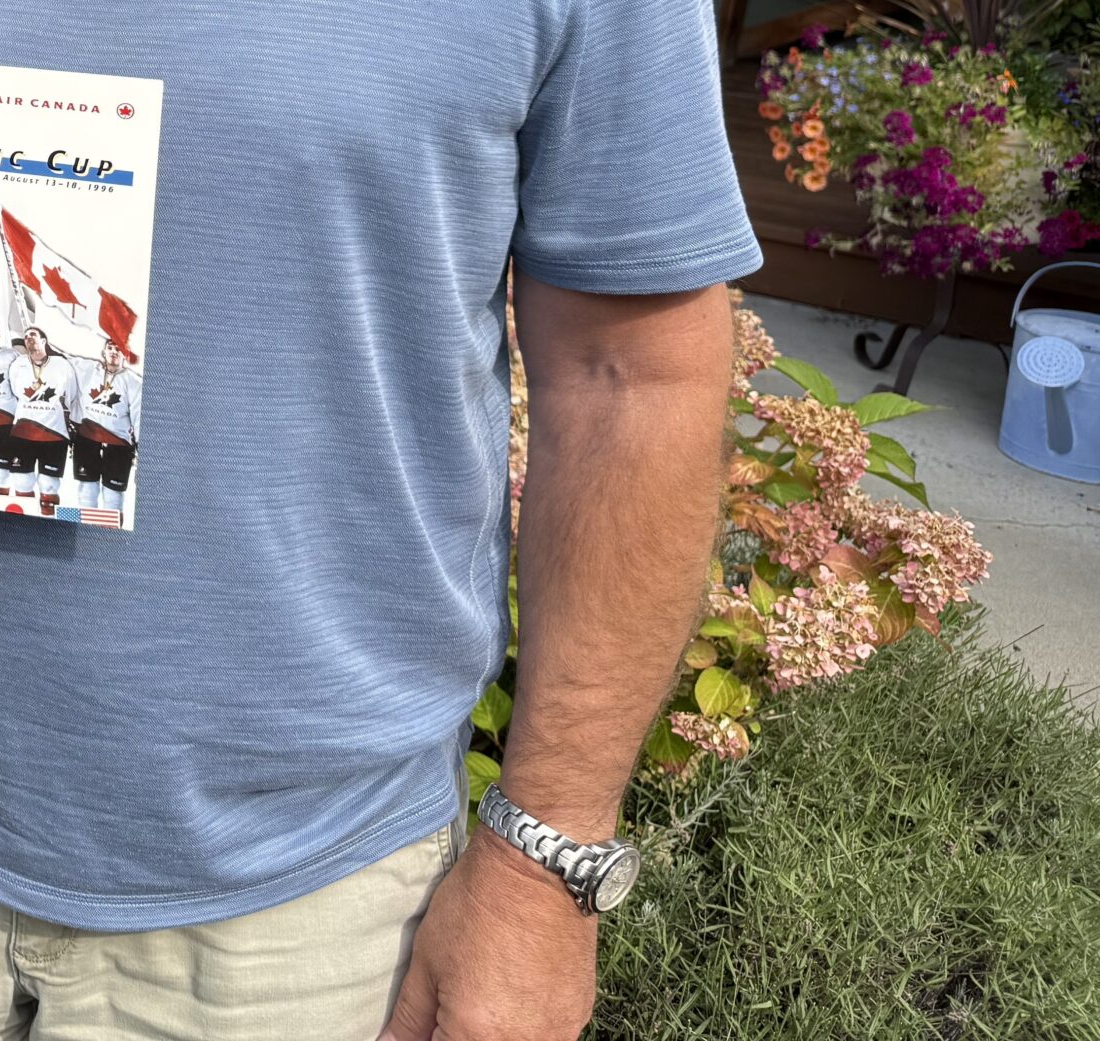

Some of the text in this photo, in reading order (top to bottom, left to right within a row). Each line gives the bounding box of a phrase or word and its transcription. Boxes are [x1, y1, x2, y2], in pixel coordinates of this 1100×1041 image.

[30, 98, 100, 114] CANADA
[46, 149, 114, 177] CUP
[2, 174, 40, 185] AUGUST
[88, 183, 114, 193] 1996
